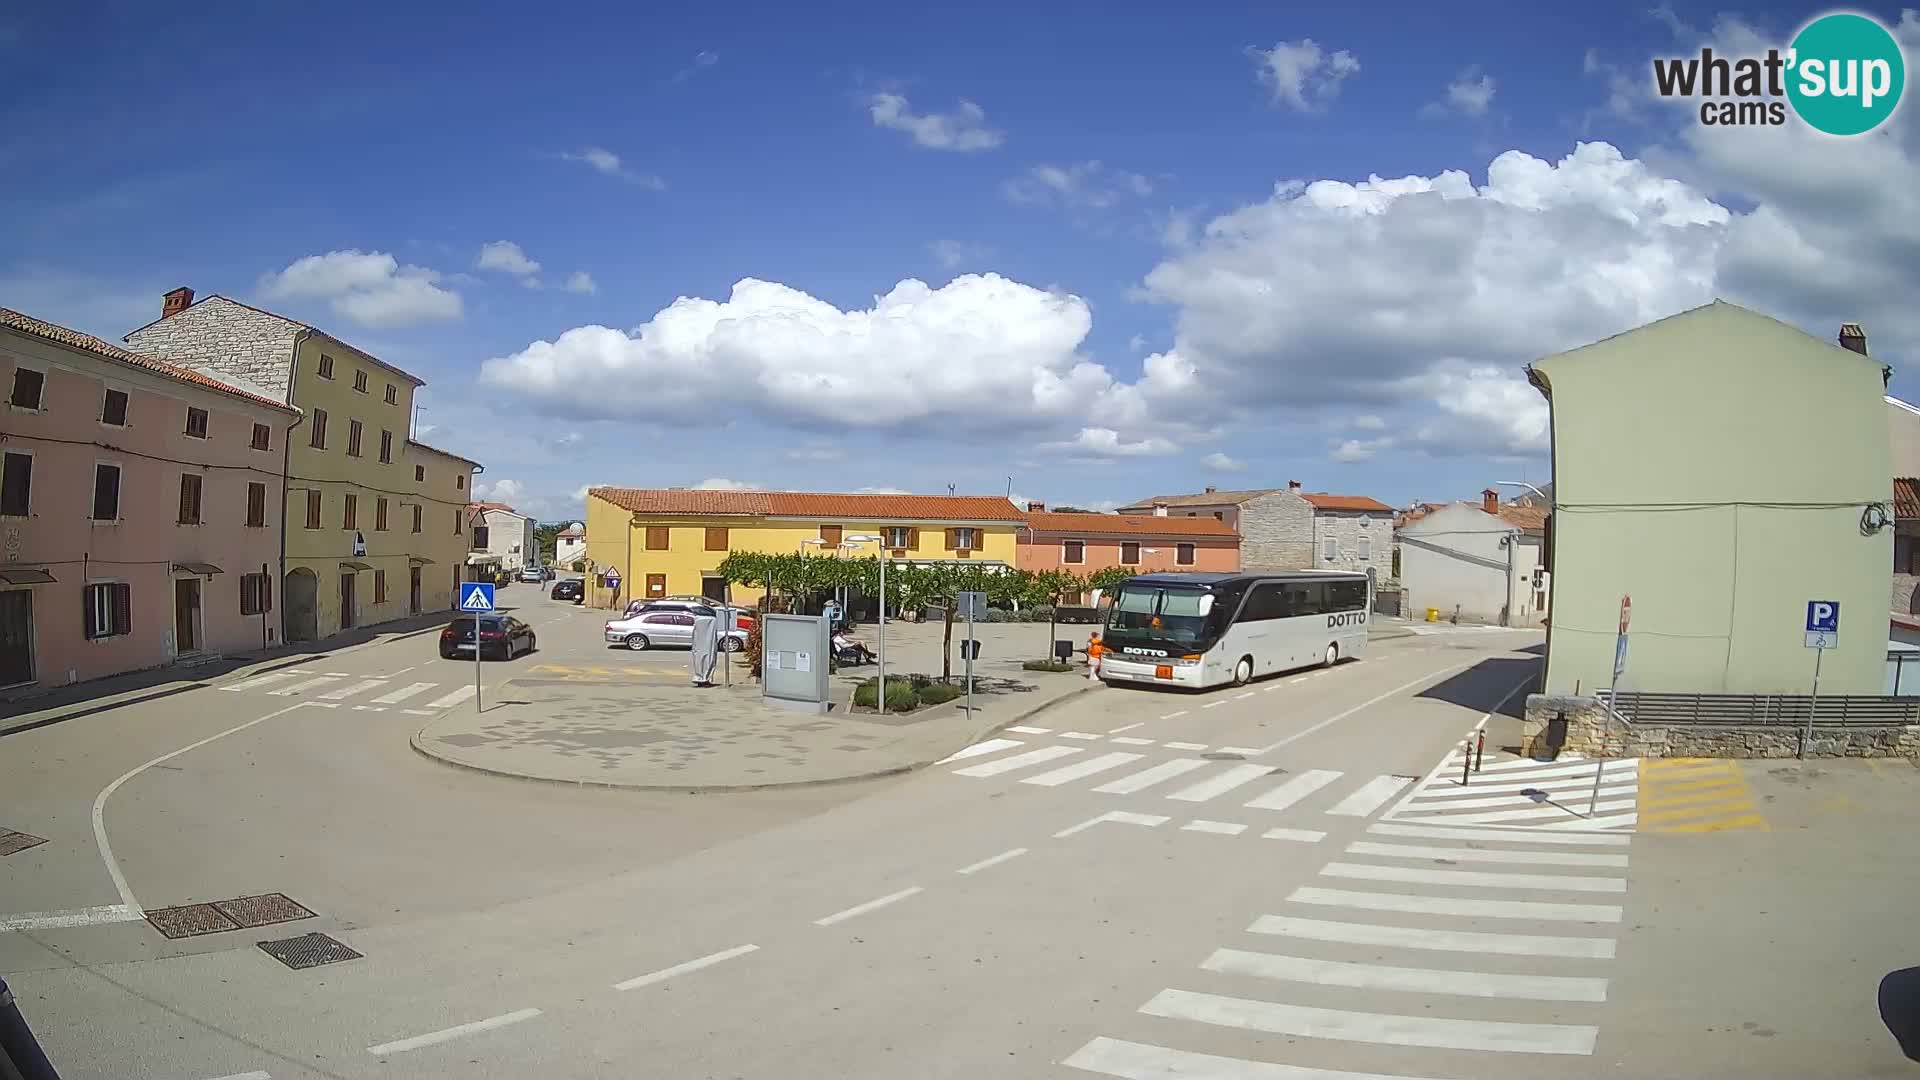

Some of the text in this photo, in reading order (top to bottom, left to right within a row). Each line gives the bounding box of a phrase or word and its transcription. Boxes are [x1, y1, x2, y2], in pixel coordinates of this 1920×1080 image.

[1327, 611, 1366, 629] DOTTO
[1813, 602, 1833, 626] P
[1123, 646, 1168, 657] DOTTO
